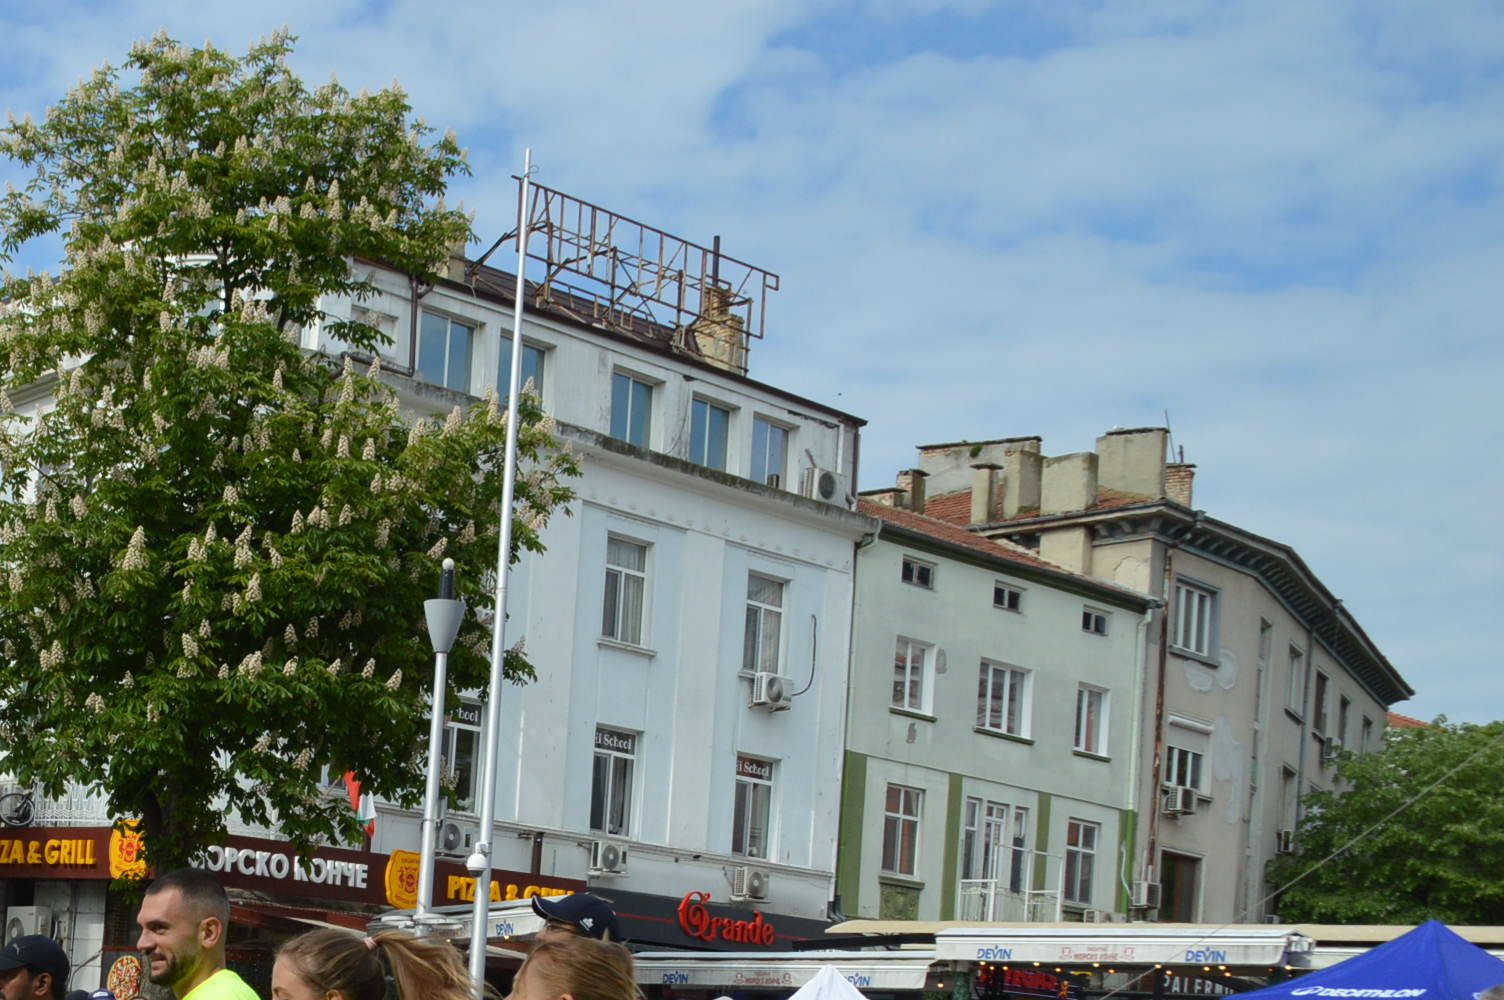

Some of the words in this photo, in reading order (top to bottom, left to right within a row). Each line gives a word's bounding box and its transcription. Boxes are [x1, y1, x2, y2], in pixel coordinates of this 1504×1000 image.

[27, 840, 42, 864] &
[44, 838, 96, 865] GRILL
[448, 875, 501, 902] PIZA
[678, 891, 775, 945] Grande
[977, 945, 1012, 960] DEVIN
[1185, 946, 1227, 963] DEVIN
[663, 970, 689, 984] DEVIN
[1318, 987, 1427, 998] DECATHLON
